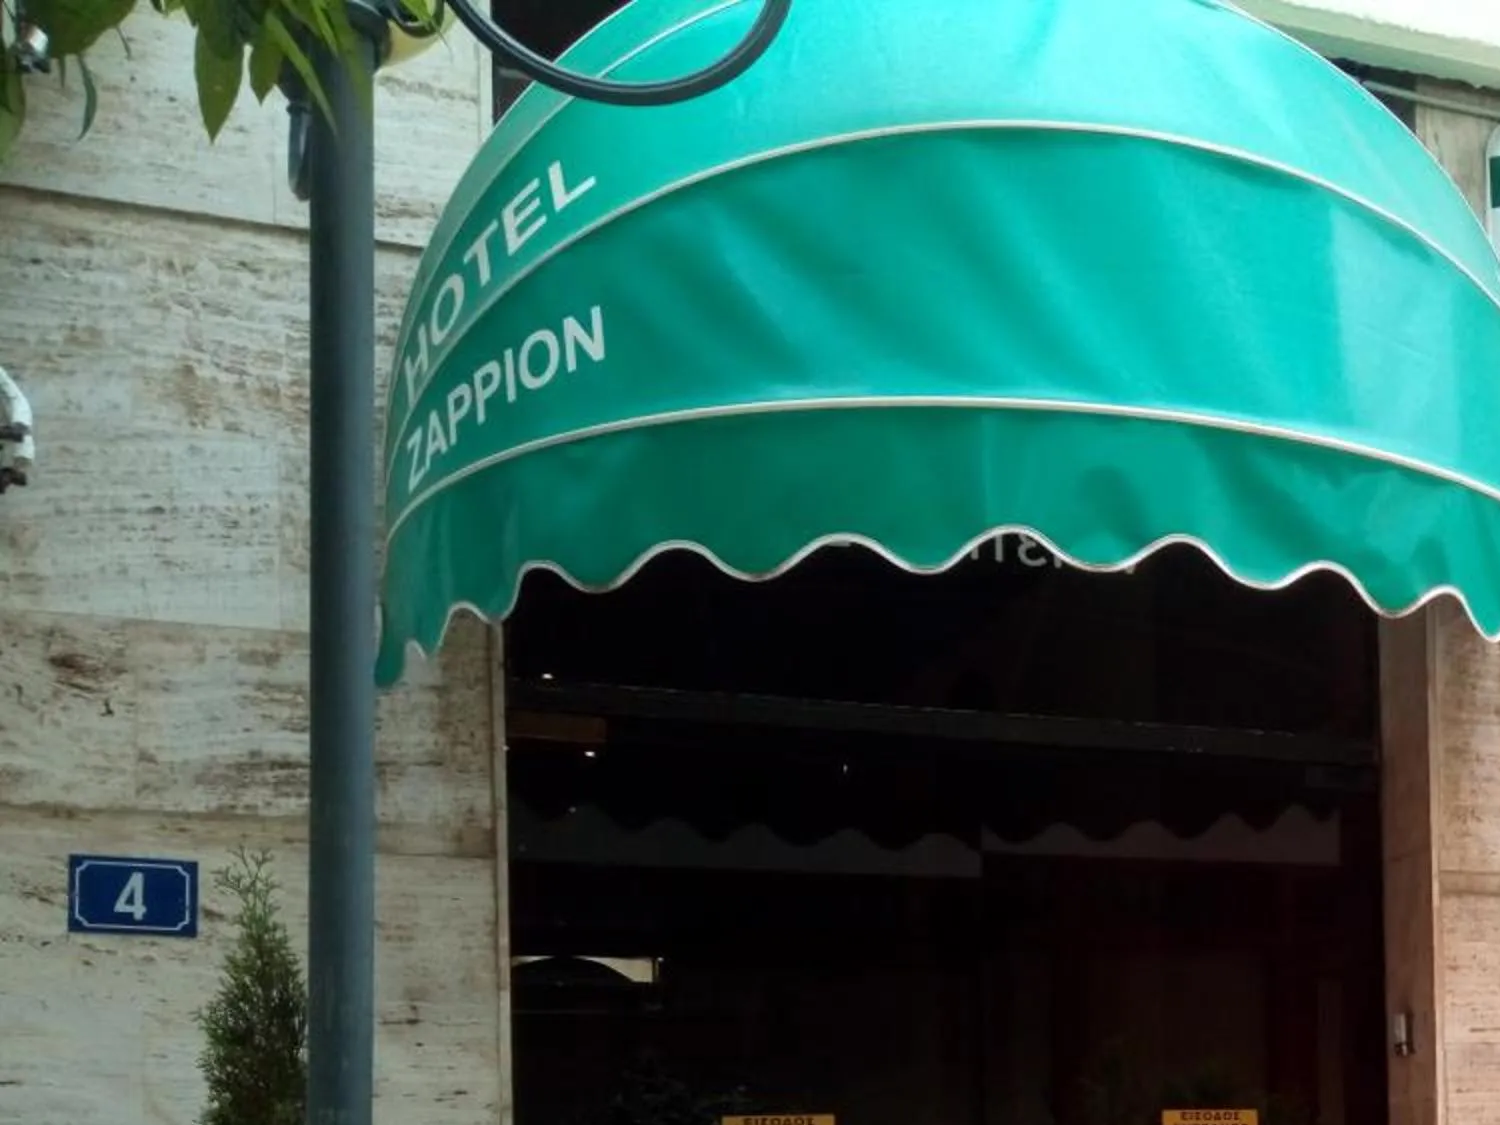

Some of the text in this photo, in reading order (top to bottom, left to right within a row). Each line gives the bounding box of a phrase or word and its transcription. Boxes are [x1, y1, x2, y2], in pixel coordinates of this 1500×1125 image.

[404, 159, 598, 405] HOTEL
[406, 304, 608, 493] ZAPPION
[113, 871, 148, 921] 4
